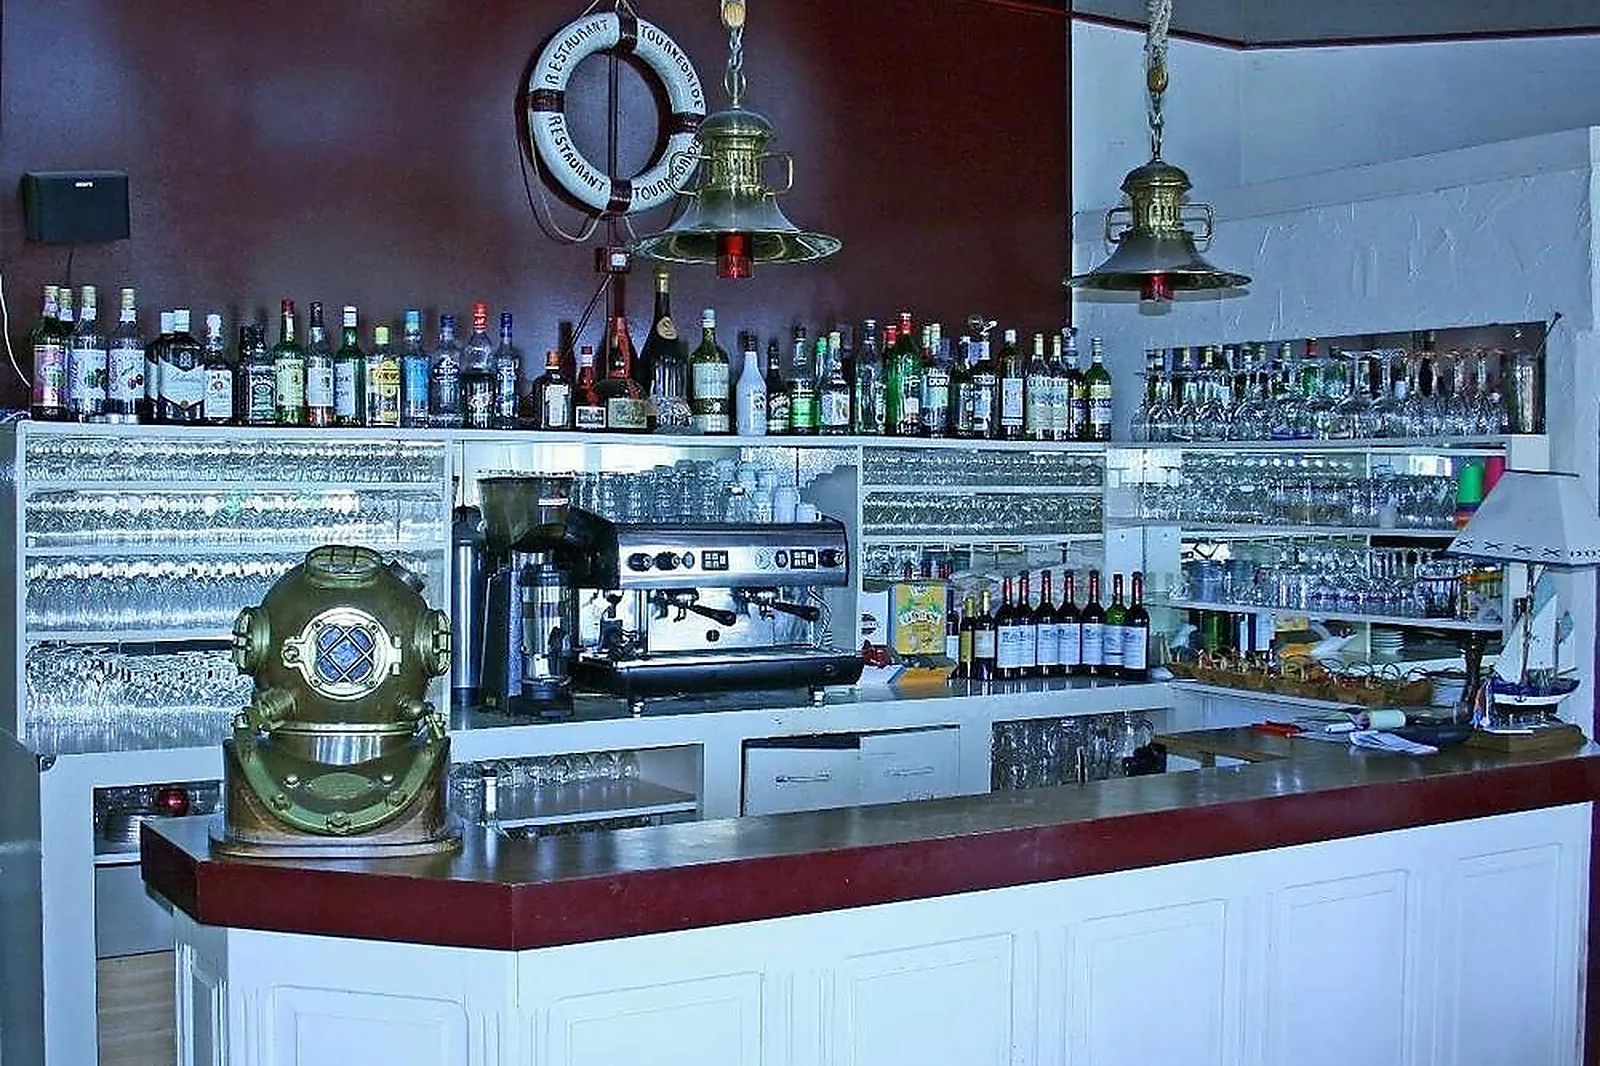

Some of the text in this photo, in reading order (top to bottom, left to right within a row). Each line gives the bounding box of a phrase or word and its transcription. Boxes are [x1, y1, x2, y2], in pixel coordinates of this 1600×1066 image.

[545, 19, 704, 109] RESTAURANT TOURNEBRIDE
[548, 115, 605, 192] RESTAURANT
